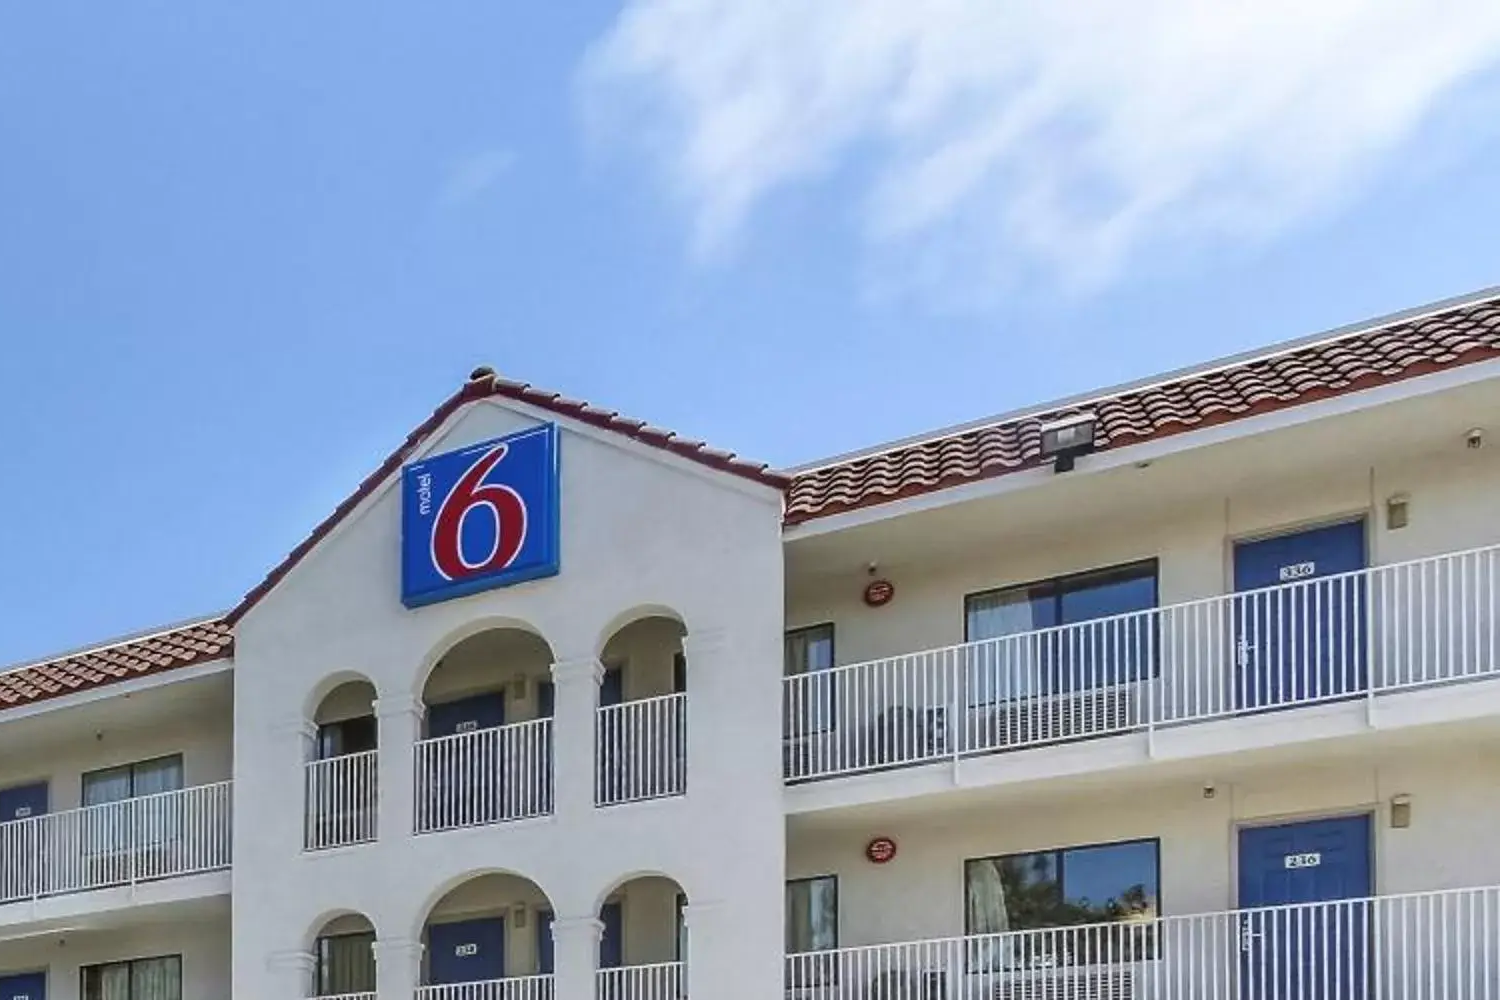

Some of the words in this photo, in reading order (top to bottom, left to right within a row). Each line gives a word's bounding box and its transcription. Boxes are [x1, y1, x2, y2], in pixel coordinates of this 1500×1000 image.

[417, 473, 431, 515] model
[430, 443, 527, 581] 6
[1287, 854, 1318, 867] 236
